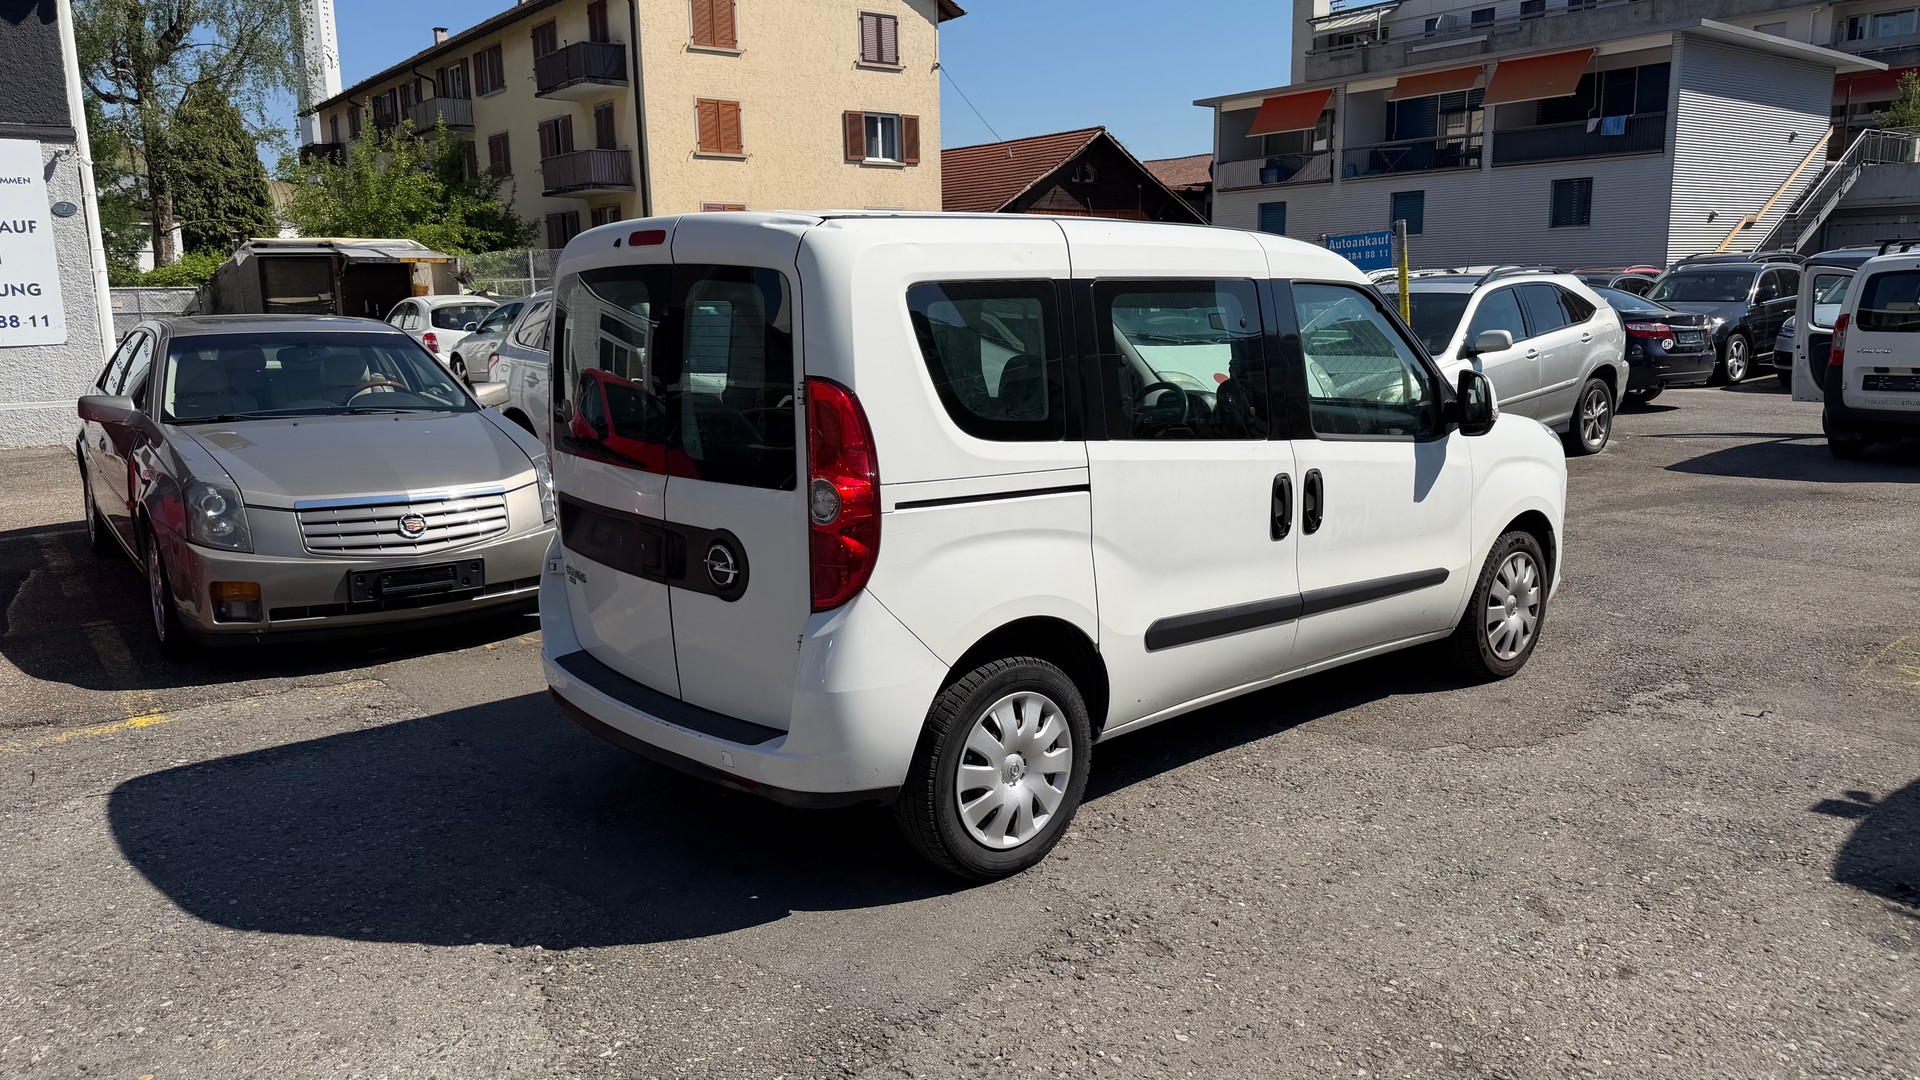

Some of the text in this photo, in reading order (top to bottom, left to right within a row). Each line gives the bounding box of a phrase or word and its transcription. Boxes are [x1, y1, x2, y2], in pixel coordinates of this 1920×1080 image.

[0, 219, 37, 233] AUF
[1328, 233, 1389, 250] Autoankauf
[1346, 251, 1362, 260] 384
[1365, 250, 1376, 259] 88
[1379, 249, 1388, 257] 11
[1663, 340, 1672, 348] CH
